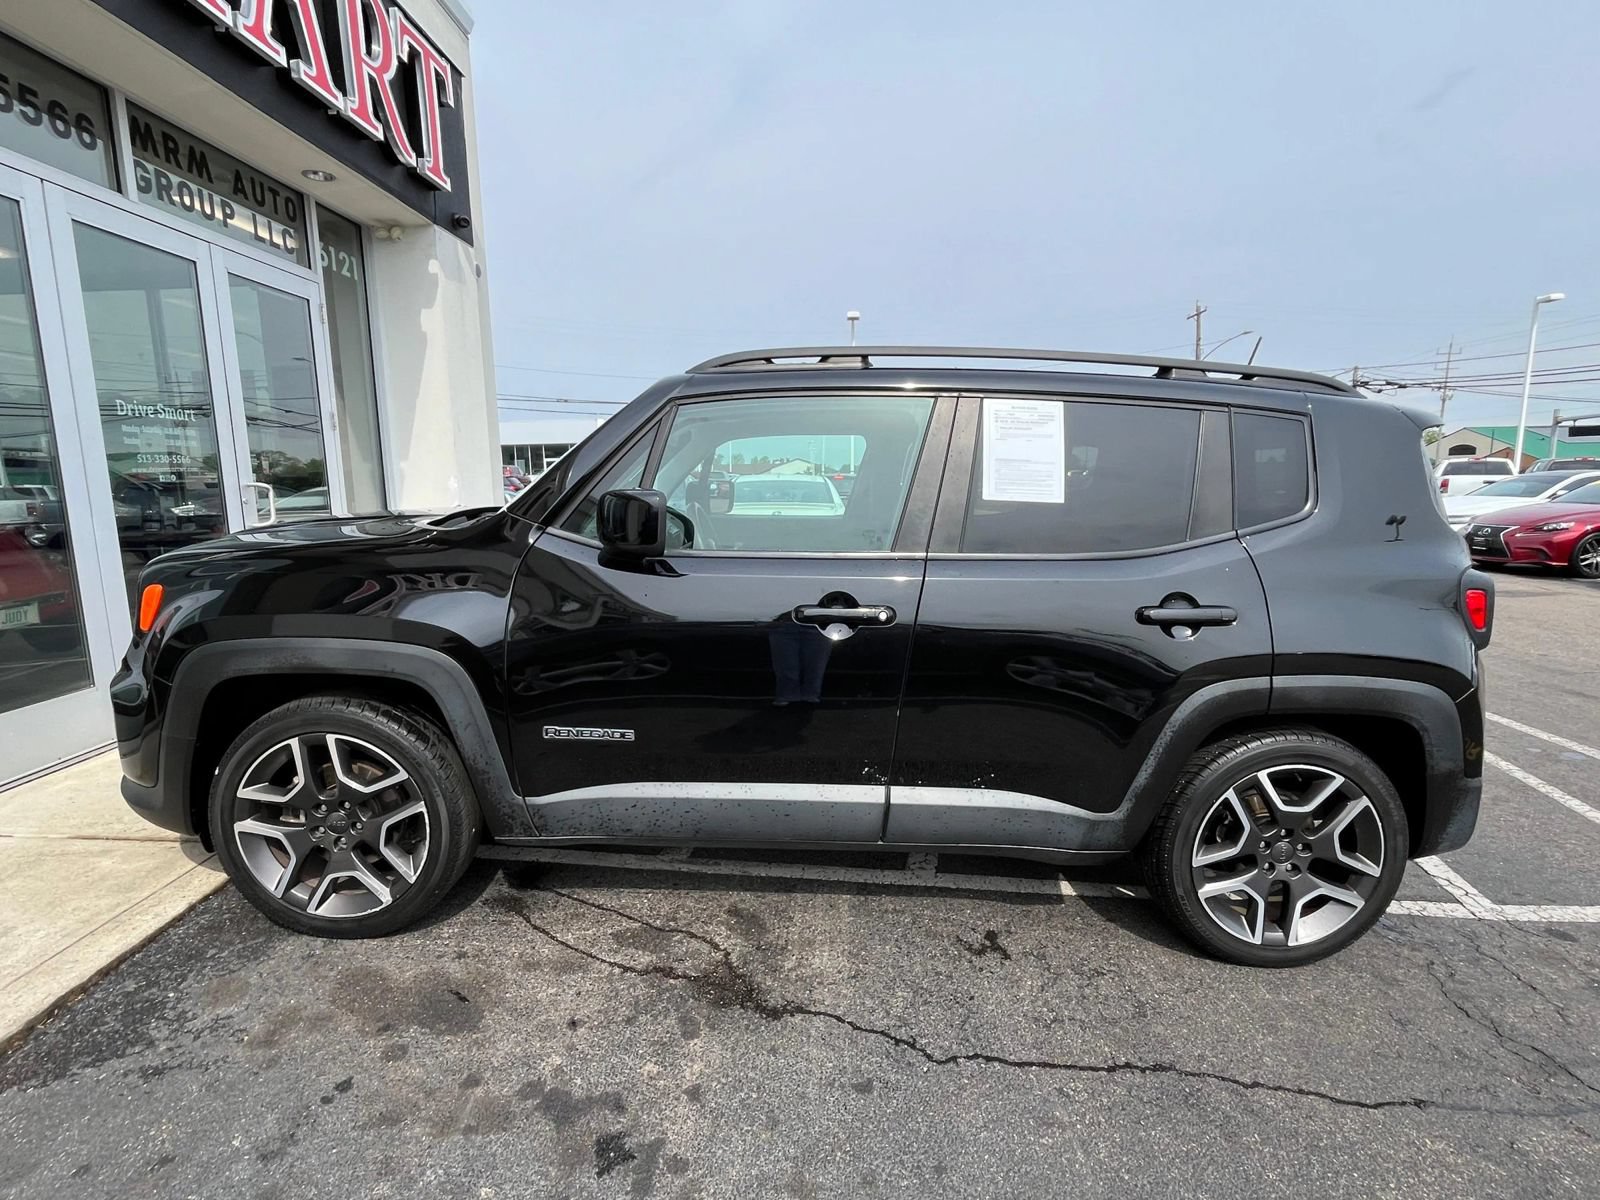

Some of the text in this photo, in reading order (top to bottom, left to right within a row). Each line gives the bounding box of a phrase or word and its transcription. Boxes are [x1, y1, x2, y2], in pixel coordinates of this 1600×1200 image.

[131, 115, 297, 223] MRM AUTO
[133, 158, 296, 254] GROUP LLC
[115, 400, 196, 422] Drive Smart
[543, 726, 635, 741] RENEGADE
